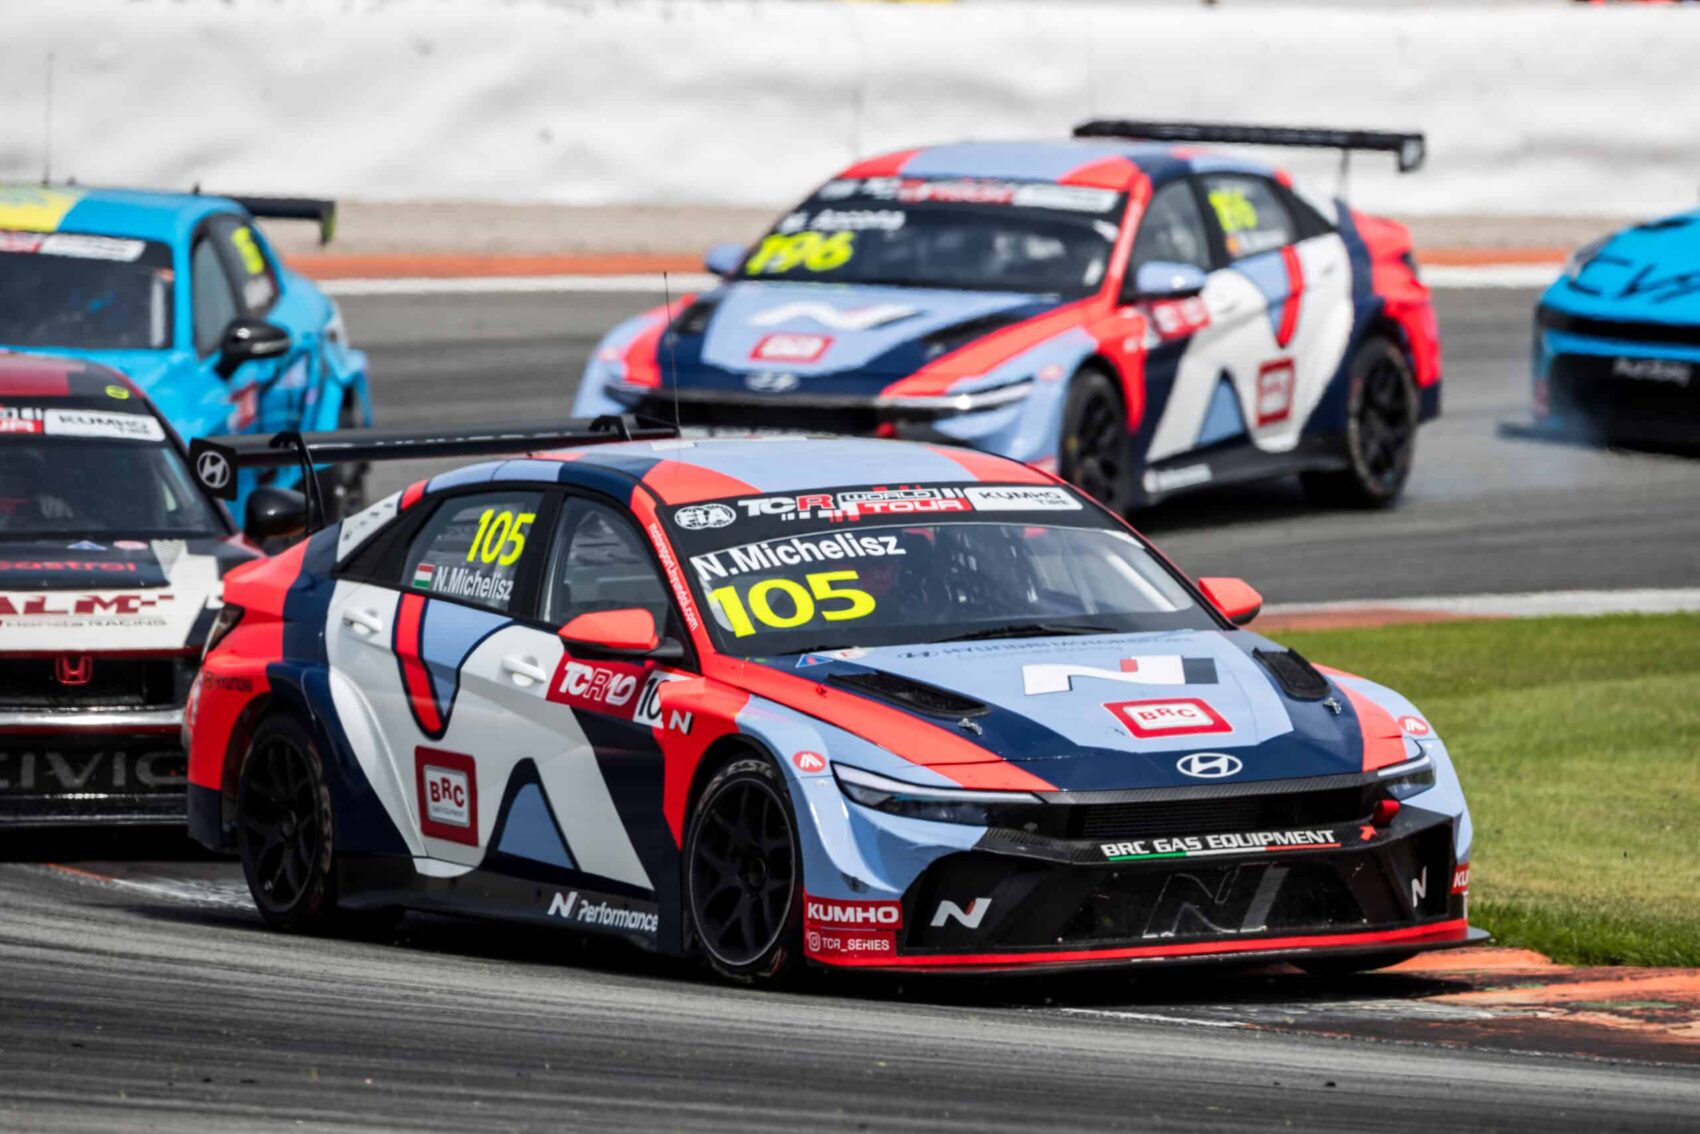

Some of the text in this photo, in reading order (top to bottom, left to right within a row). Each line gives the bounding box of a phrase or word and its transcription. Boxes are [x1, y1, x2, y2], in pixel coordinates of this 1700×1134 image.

[738, 494, 836, 516] TCR
[845, 489, 934, 500] WORLD
[864, 500, 964, 512] TOUR
[979, 491, 1063, 500] KUMHO
[678, 506, 732, 527] FIA
[466, 508, 536, 566] 105
[688, 532, 906, 581] N.Michelisz
[433, 565, 514, 600] N.Michelisz
[710, 570, 876, 638] 105
[1137, 707, 1199, 721] BRC
[0, 751, 188, 787] IVIC
[429, 777, 465, 808] BRC
[1101, 830, 1336, 857] BRC GAS EQUIPMENT
[577, 899, 659, 932] Performance
[807, 902, 899, 923] KUMHO
[822, 936, 890, 952] TCR_SERIES
